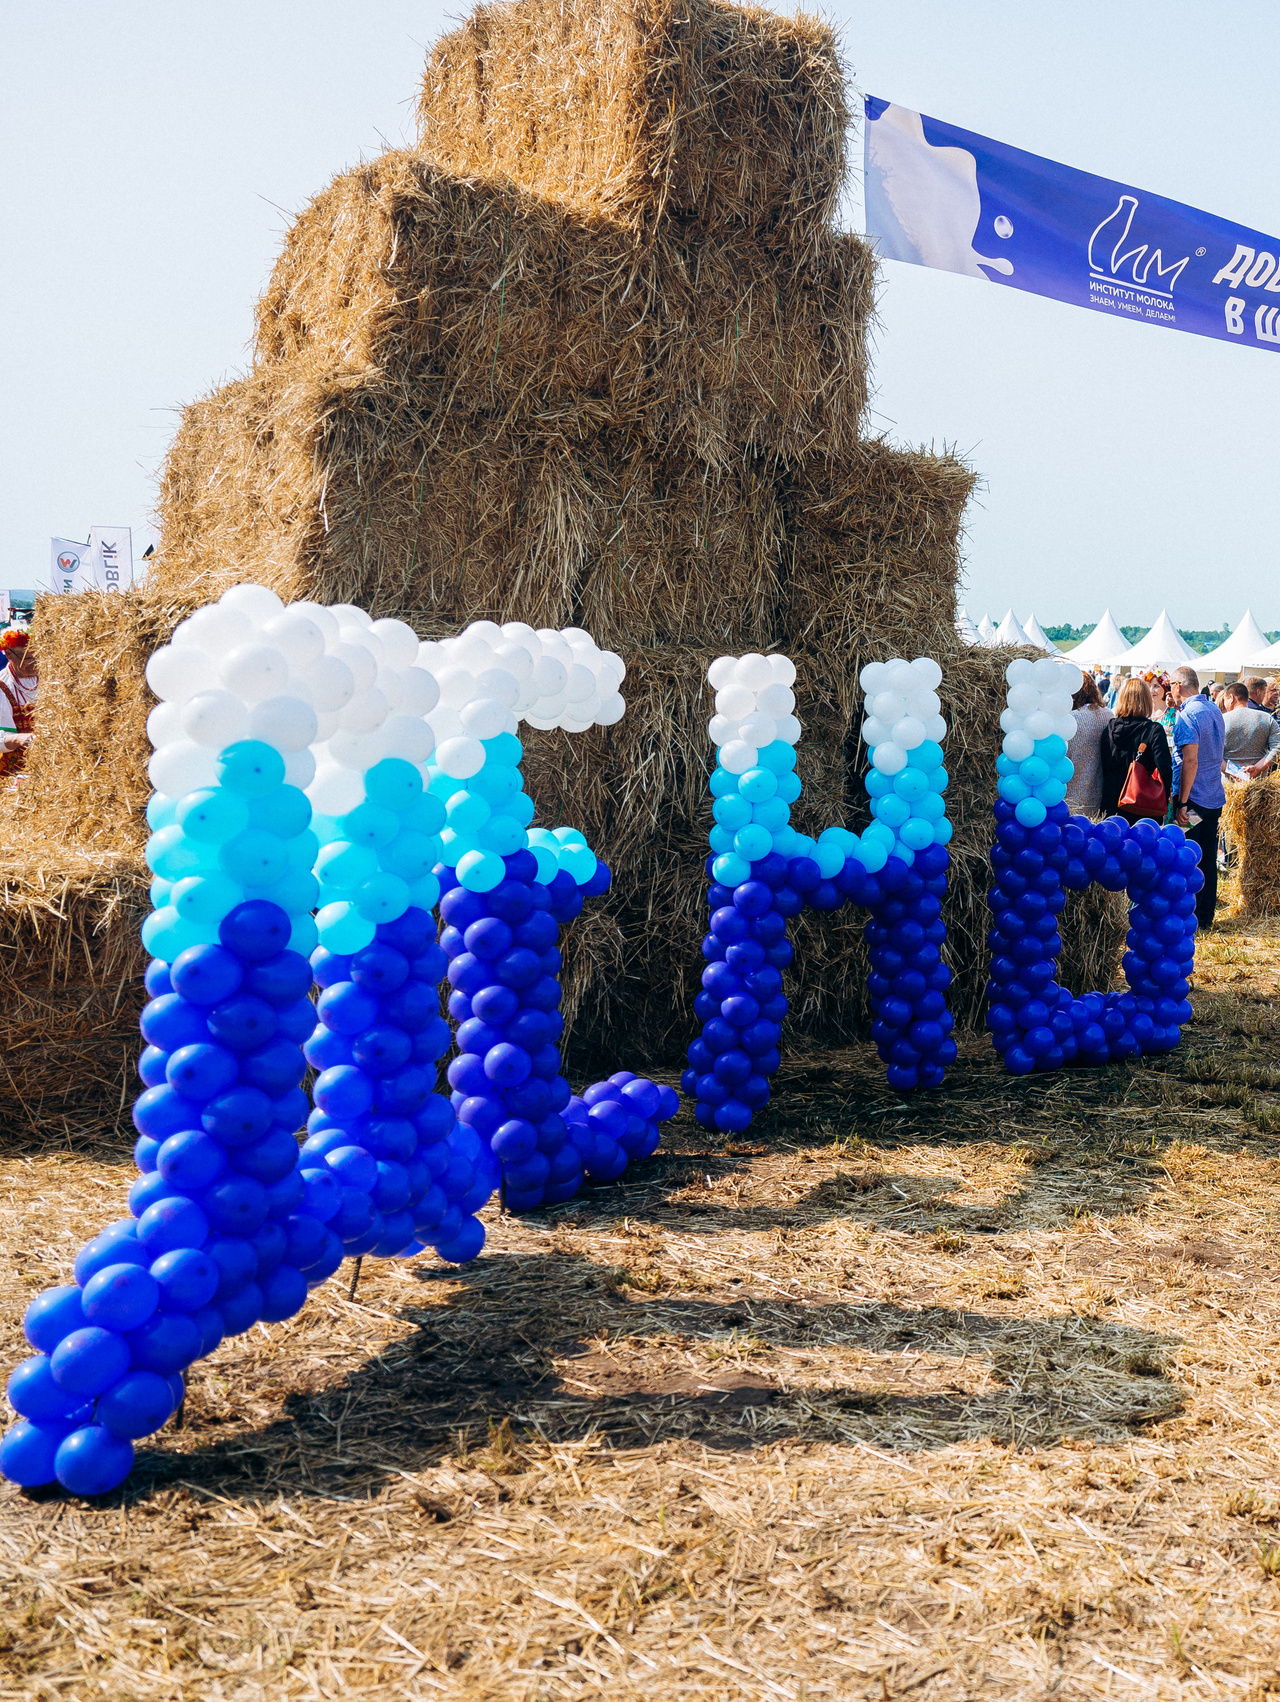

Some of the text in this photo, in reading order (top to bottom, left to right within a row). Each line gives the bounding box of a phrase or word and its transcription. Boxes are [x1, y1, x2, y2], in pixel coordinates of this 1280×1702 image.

[1089, 280, 1175, 311] ИНСТИТУТ МОЛОКА
[1089, 294, 1176, 323] ЗНАЕМ, УМЕЕМ, ДЕЛАЕМ!
[1224, 296, 1246, 334] В
